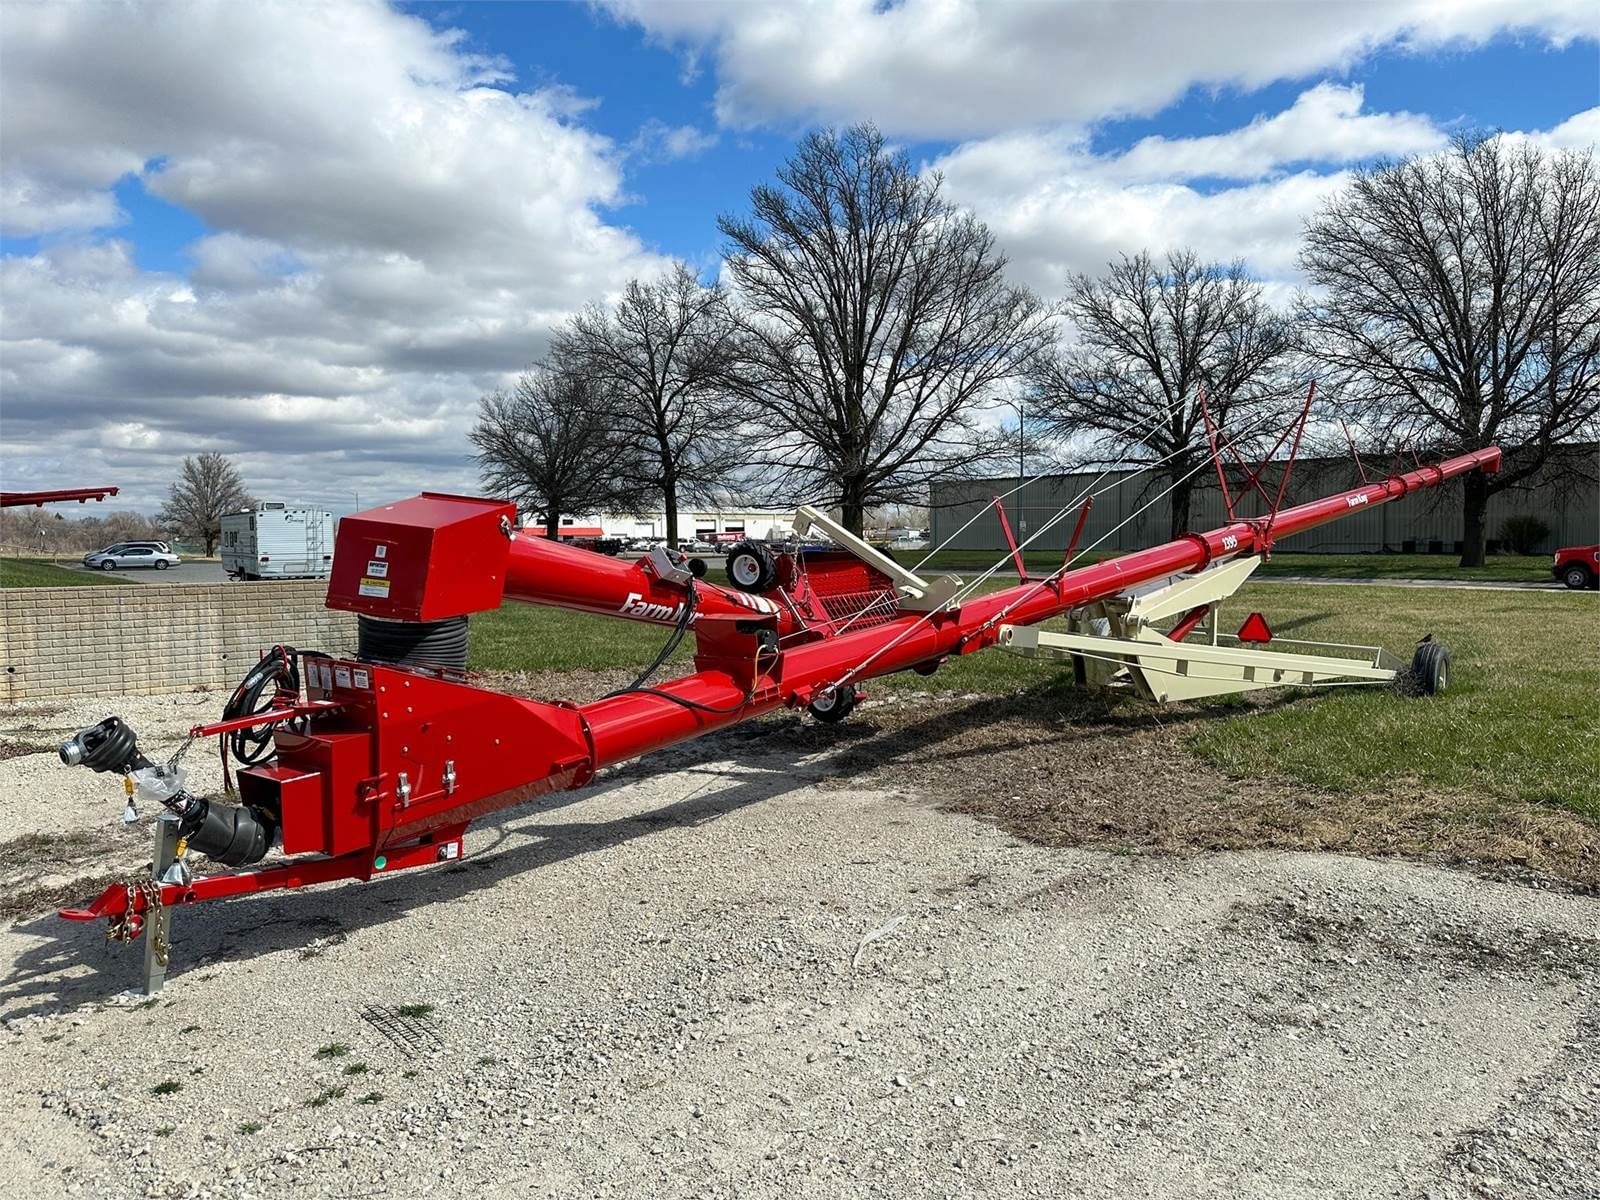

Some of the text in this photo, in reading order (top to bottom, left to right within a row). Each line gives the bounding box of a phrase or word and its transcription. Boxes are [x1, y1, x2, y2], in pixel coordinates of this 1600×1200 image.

[1346, 495, 1359, 508] Farm
[1221, 535, 1238, 550] 1395
[618, 592, 674, 620] Farm
